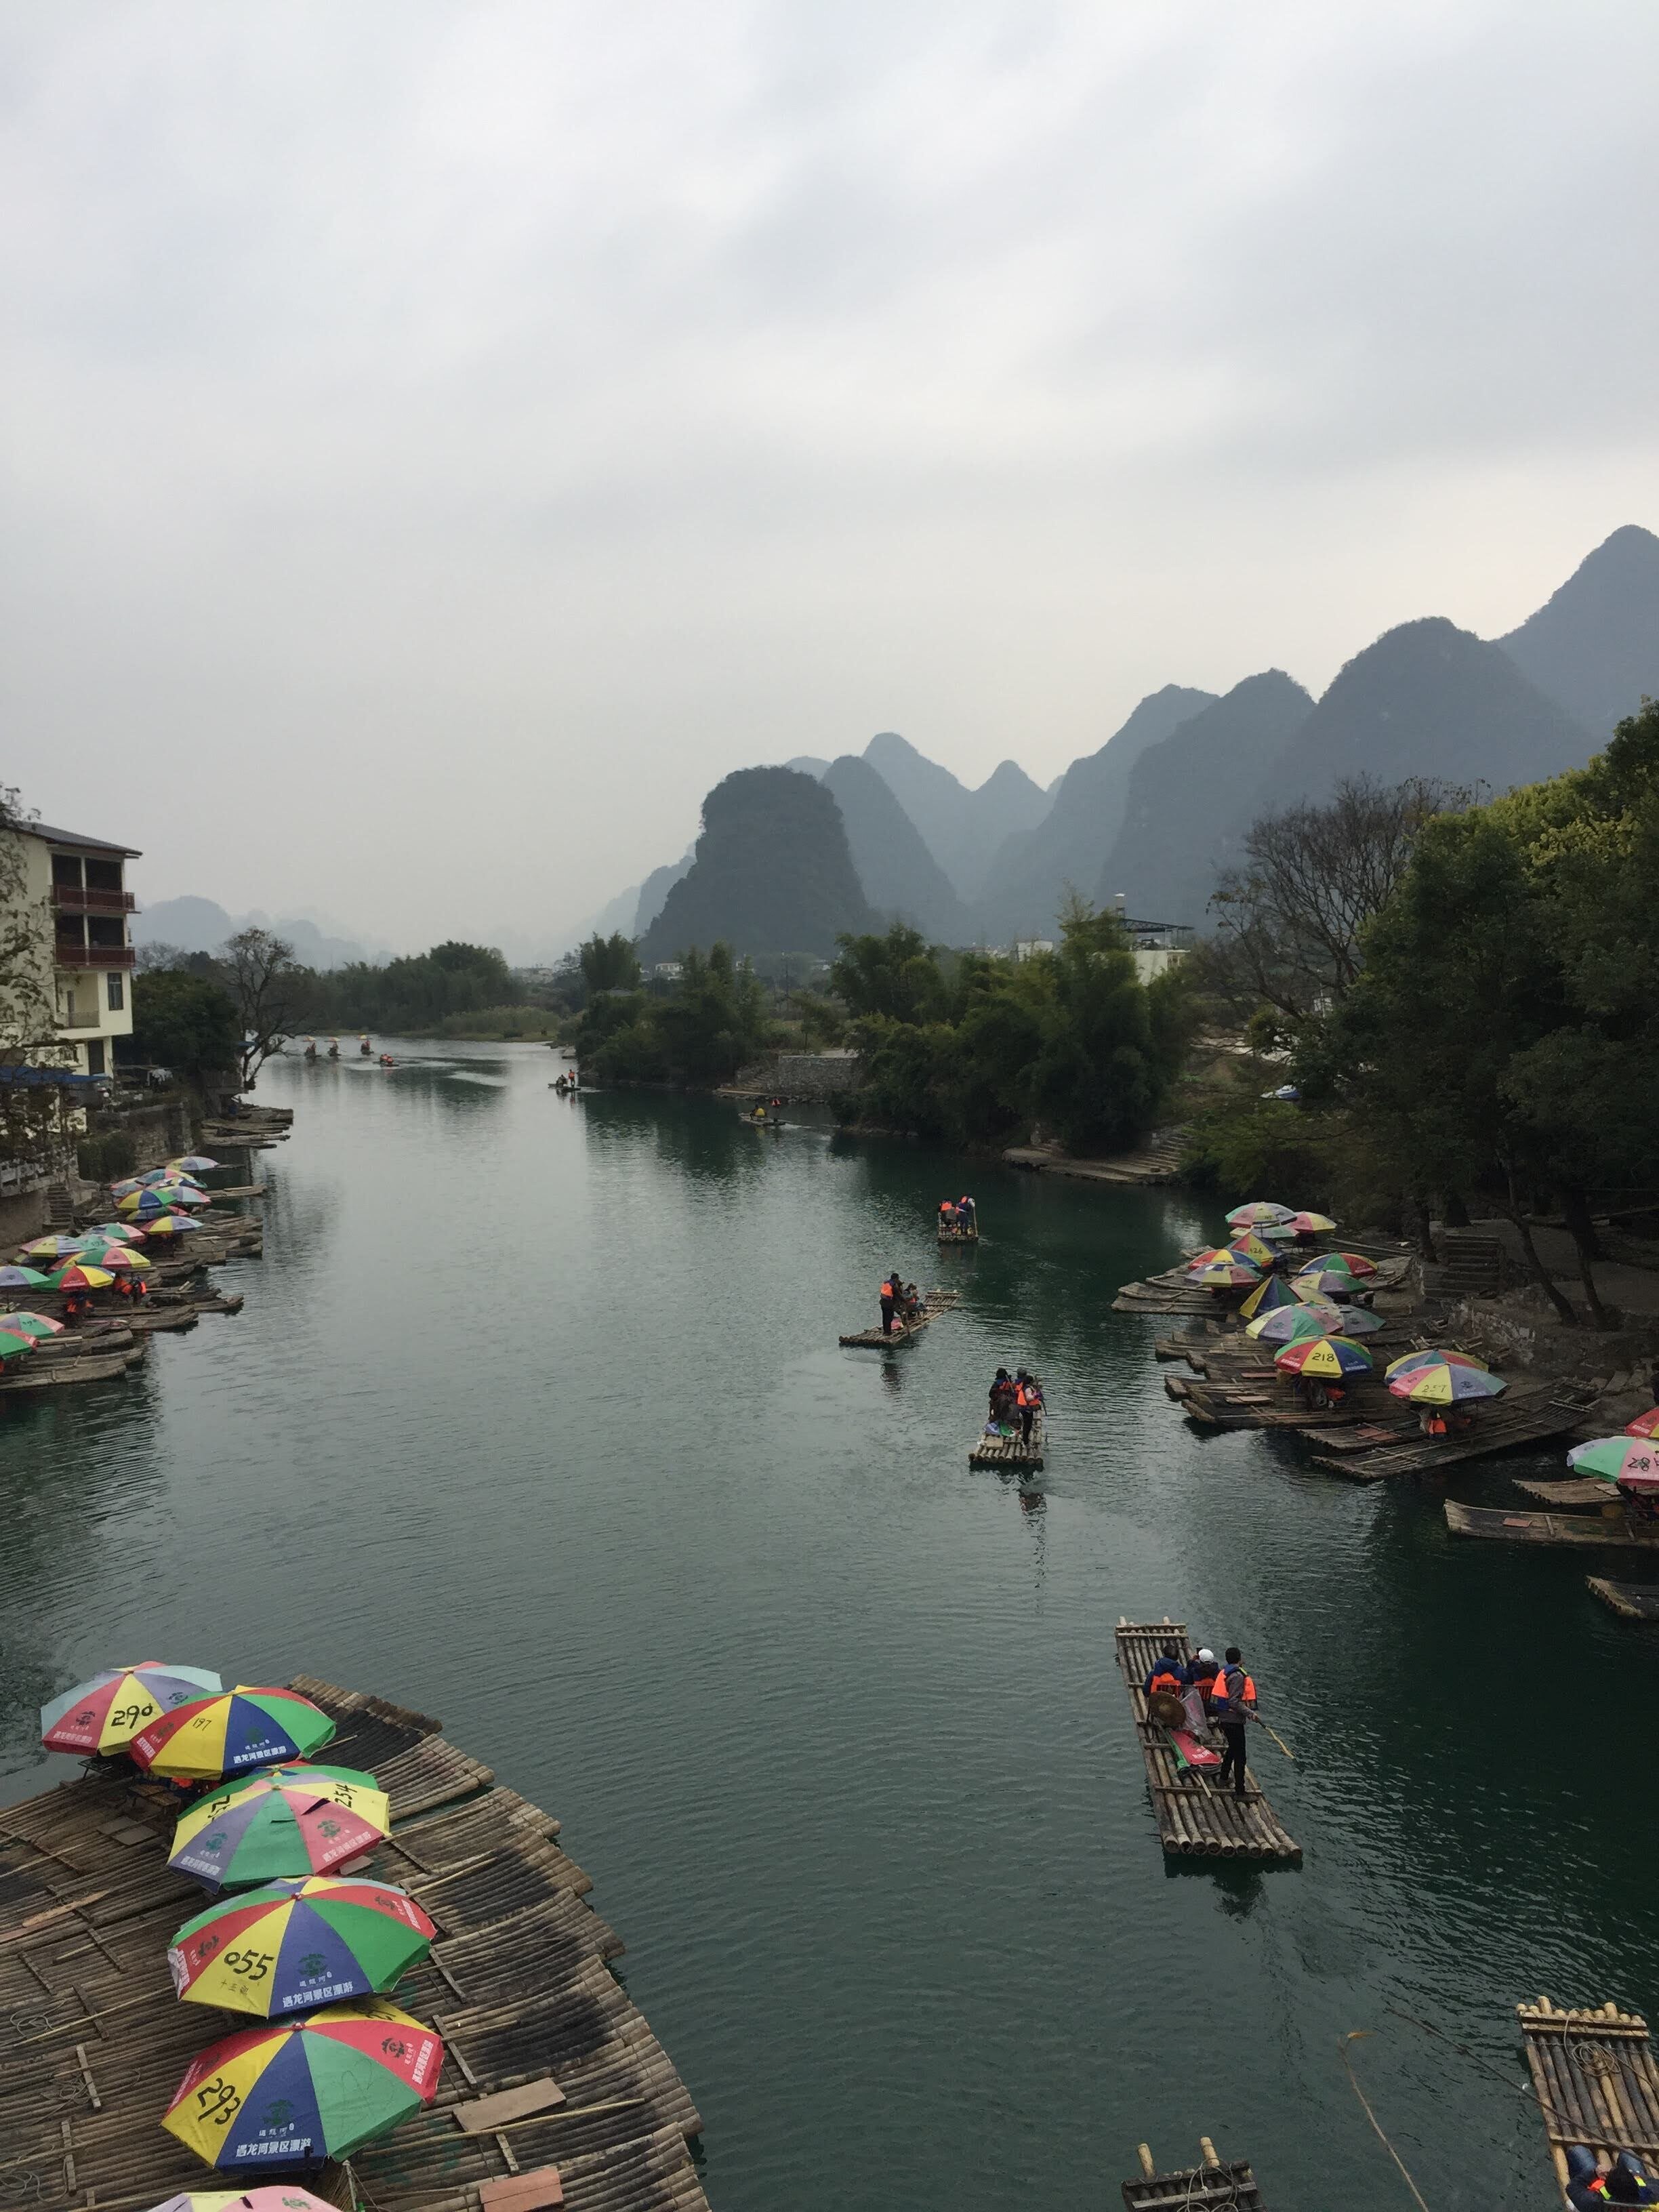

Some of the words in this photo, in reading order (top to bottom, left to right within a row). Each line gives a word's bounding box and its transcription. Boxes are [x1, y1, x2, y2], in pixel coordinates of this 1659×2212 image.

[1312, 1353, 1335, 1361] 218
[111, 1704, 153, 1729] 290
[192, 1718, 211, 1731] 197
[333, 1784, 358, 1808] 254
[224, 1949, 274, 1980] 055
[197, 2077, 241, 2125] 293
